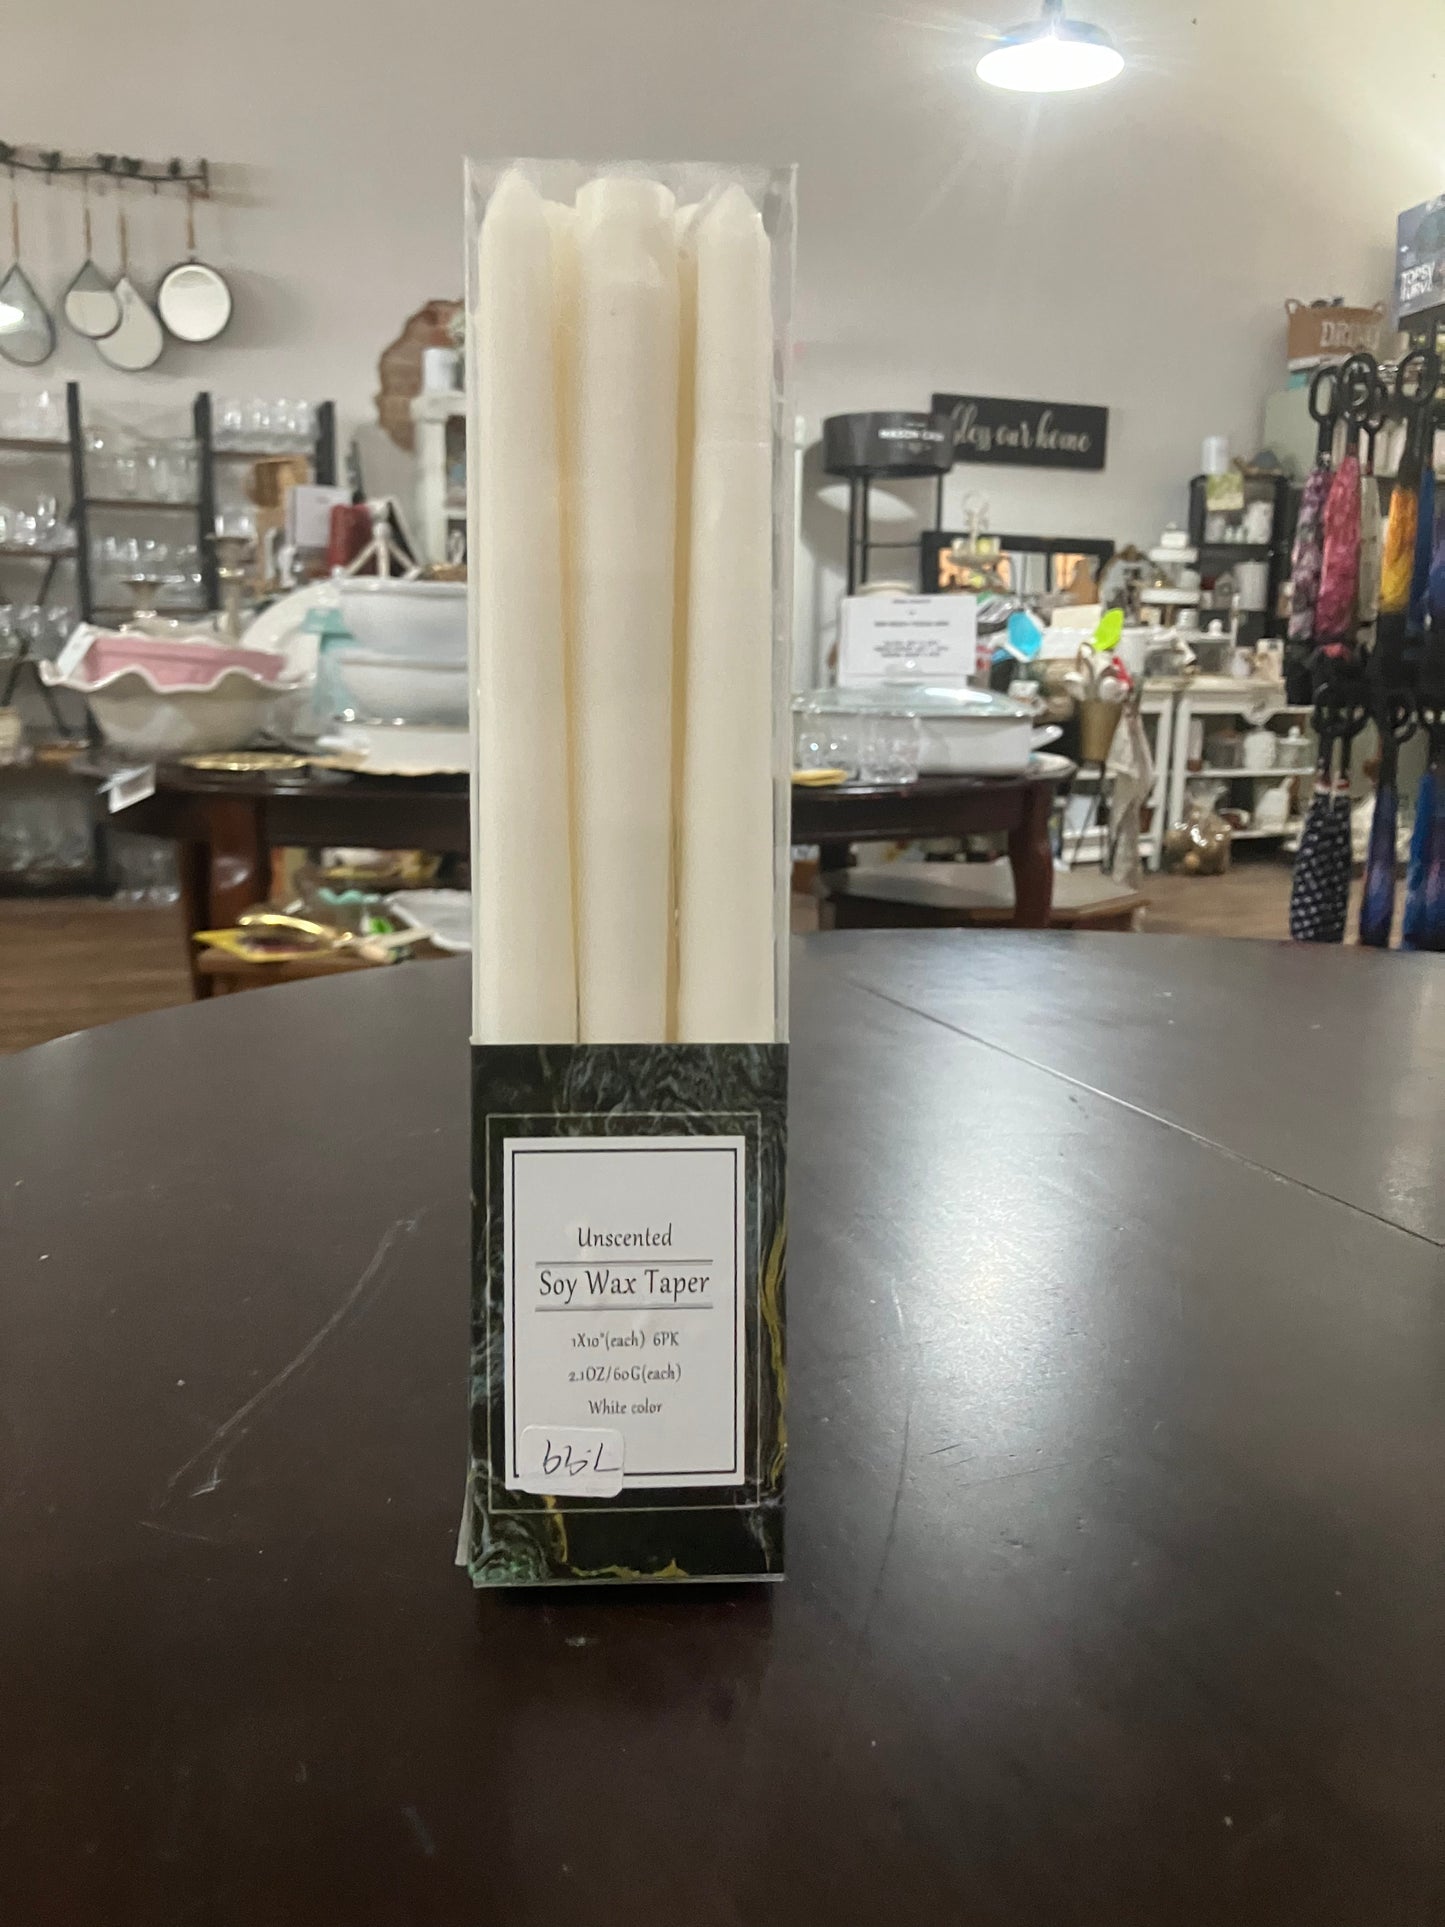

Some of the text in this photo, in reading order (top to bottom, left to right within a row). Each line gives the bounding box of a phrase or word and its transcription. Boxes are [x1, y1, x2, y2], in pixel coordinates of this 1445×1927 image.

[1034, 410, 1091, 452] home
[578, 1222, 672, 1247] Unscented
[539, 1268, 710, 1304] Soy Wax Taper
[653, 1331, 679, 1347] 6PK
[568, 1361, 681, 1383] 2.1OZ/60G(each)
[588, 1397, 662, 1414] White color
[543, 1439, 620, 1476] 7.99
